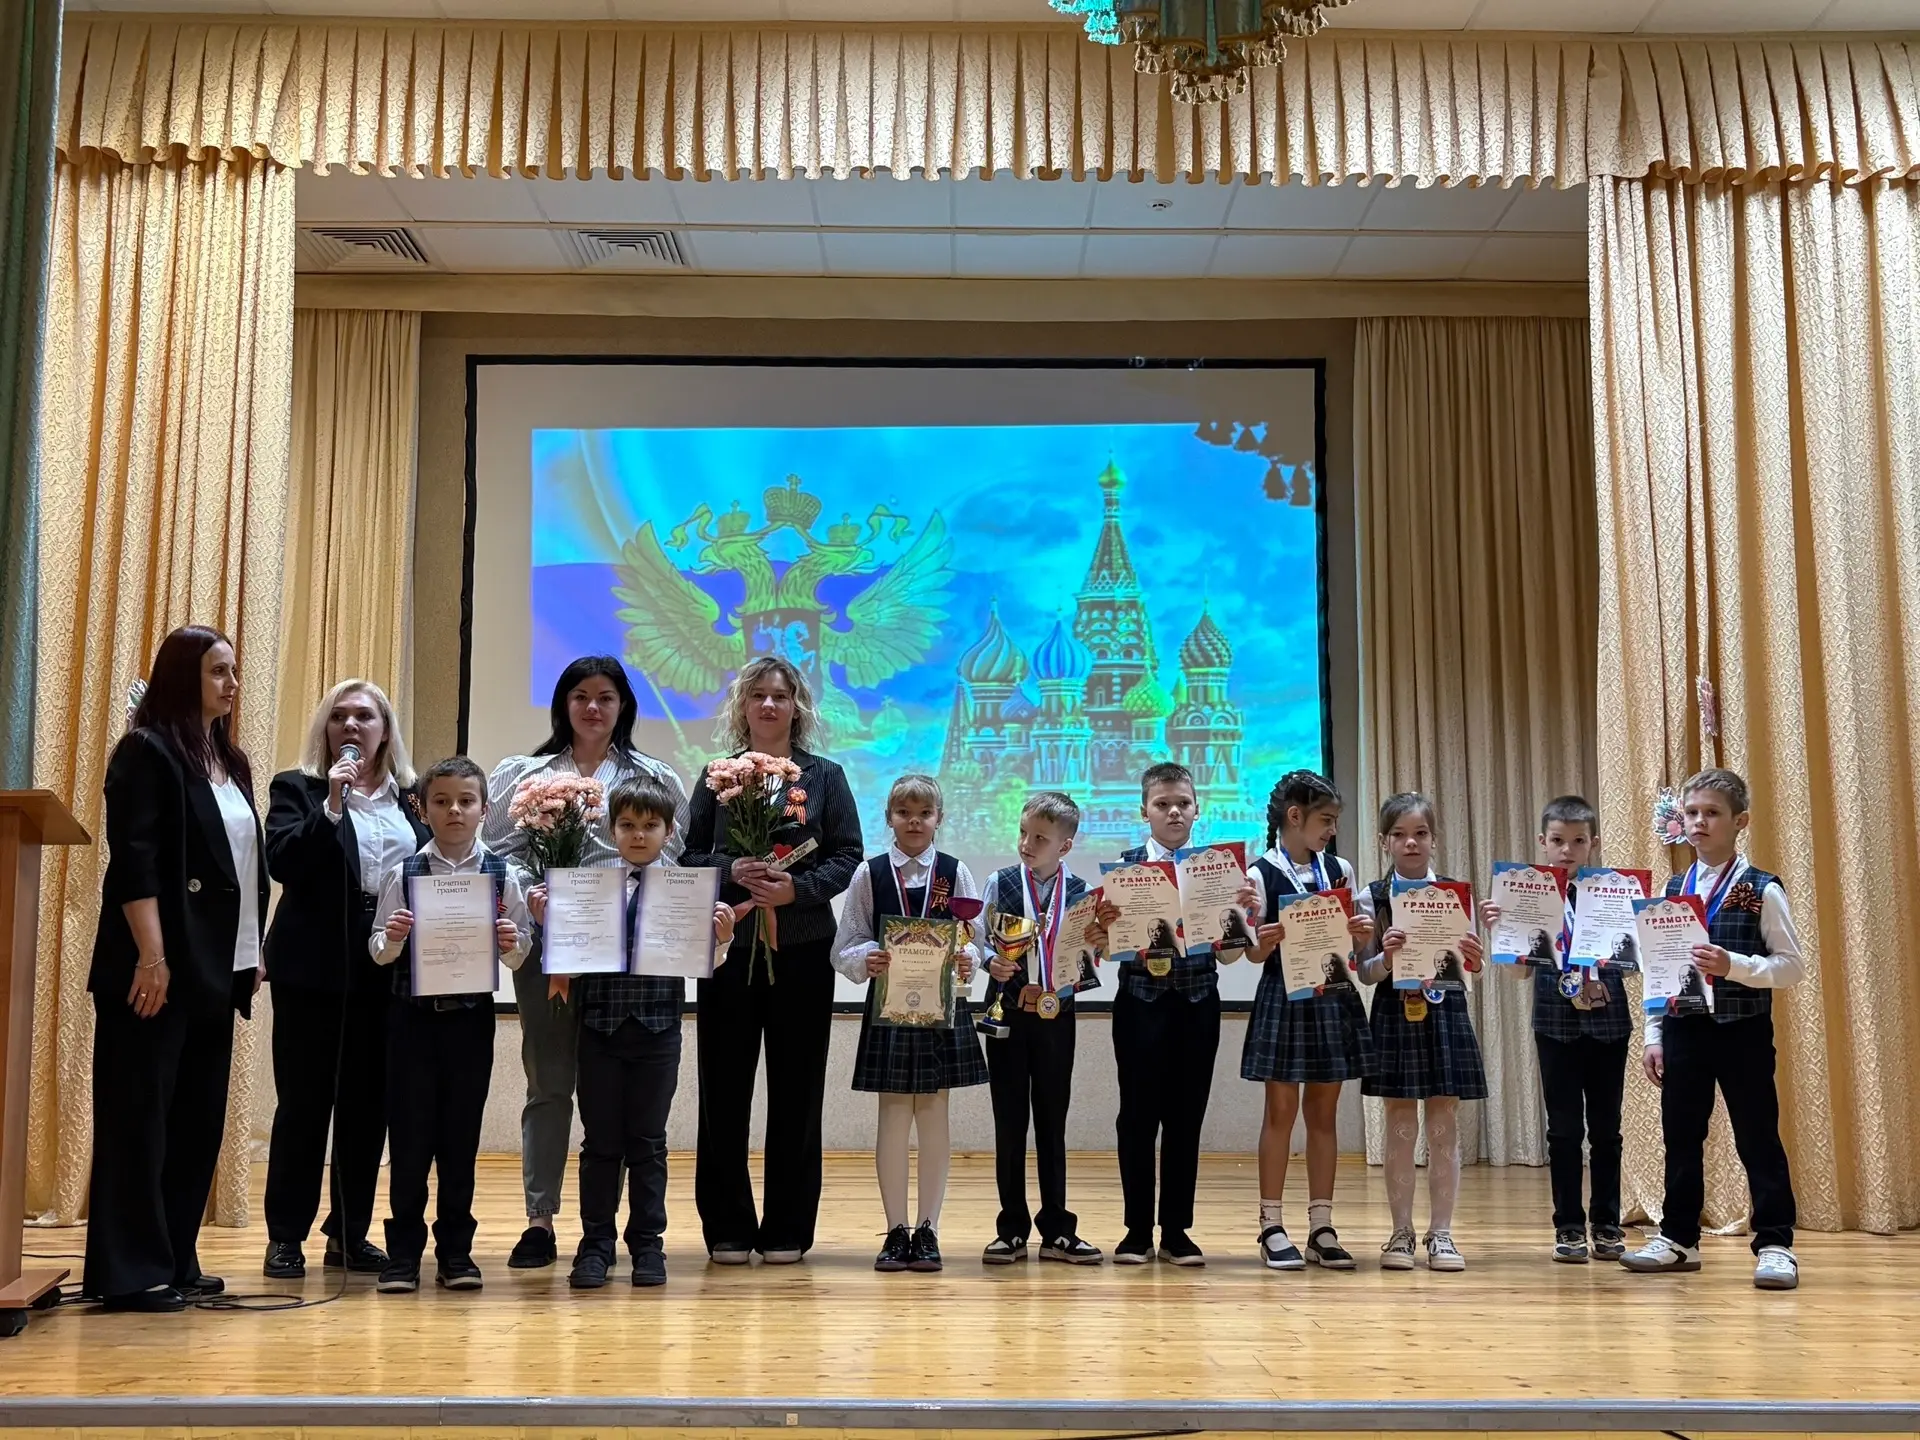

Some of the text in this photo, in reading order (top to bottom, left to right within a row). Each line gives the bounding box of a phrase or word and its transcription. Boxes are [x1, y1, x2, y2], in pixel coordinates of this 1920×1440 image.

[1186, 862, 1237, 874] ГРАМОТА
[666, 878, 695, 886] грамота
[1112, 876, 1168, 884] ГРАМОТА
[1503, 881, 1557, 892] ГРАМОТА
[1587, 886, 1641, 895] ГРАМОТА
[437, 887, 468, 896] грамота
[1403, 901, 1460, 910] ГРАМОТА
[1289, 907, 1342, 920] ГРАМОТА
[1645, 915, 1697, 925] ГРАМОТА
[899, 948, 935, 956] ГРАМОТА
